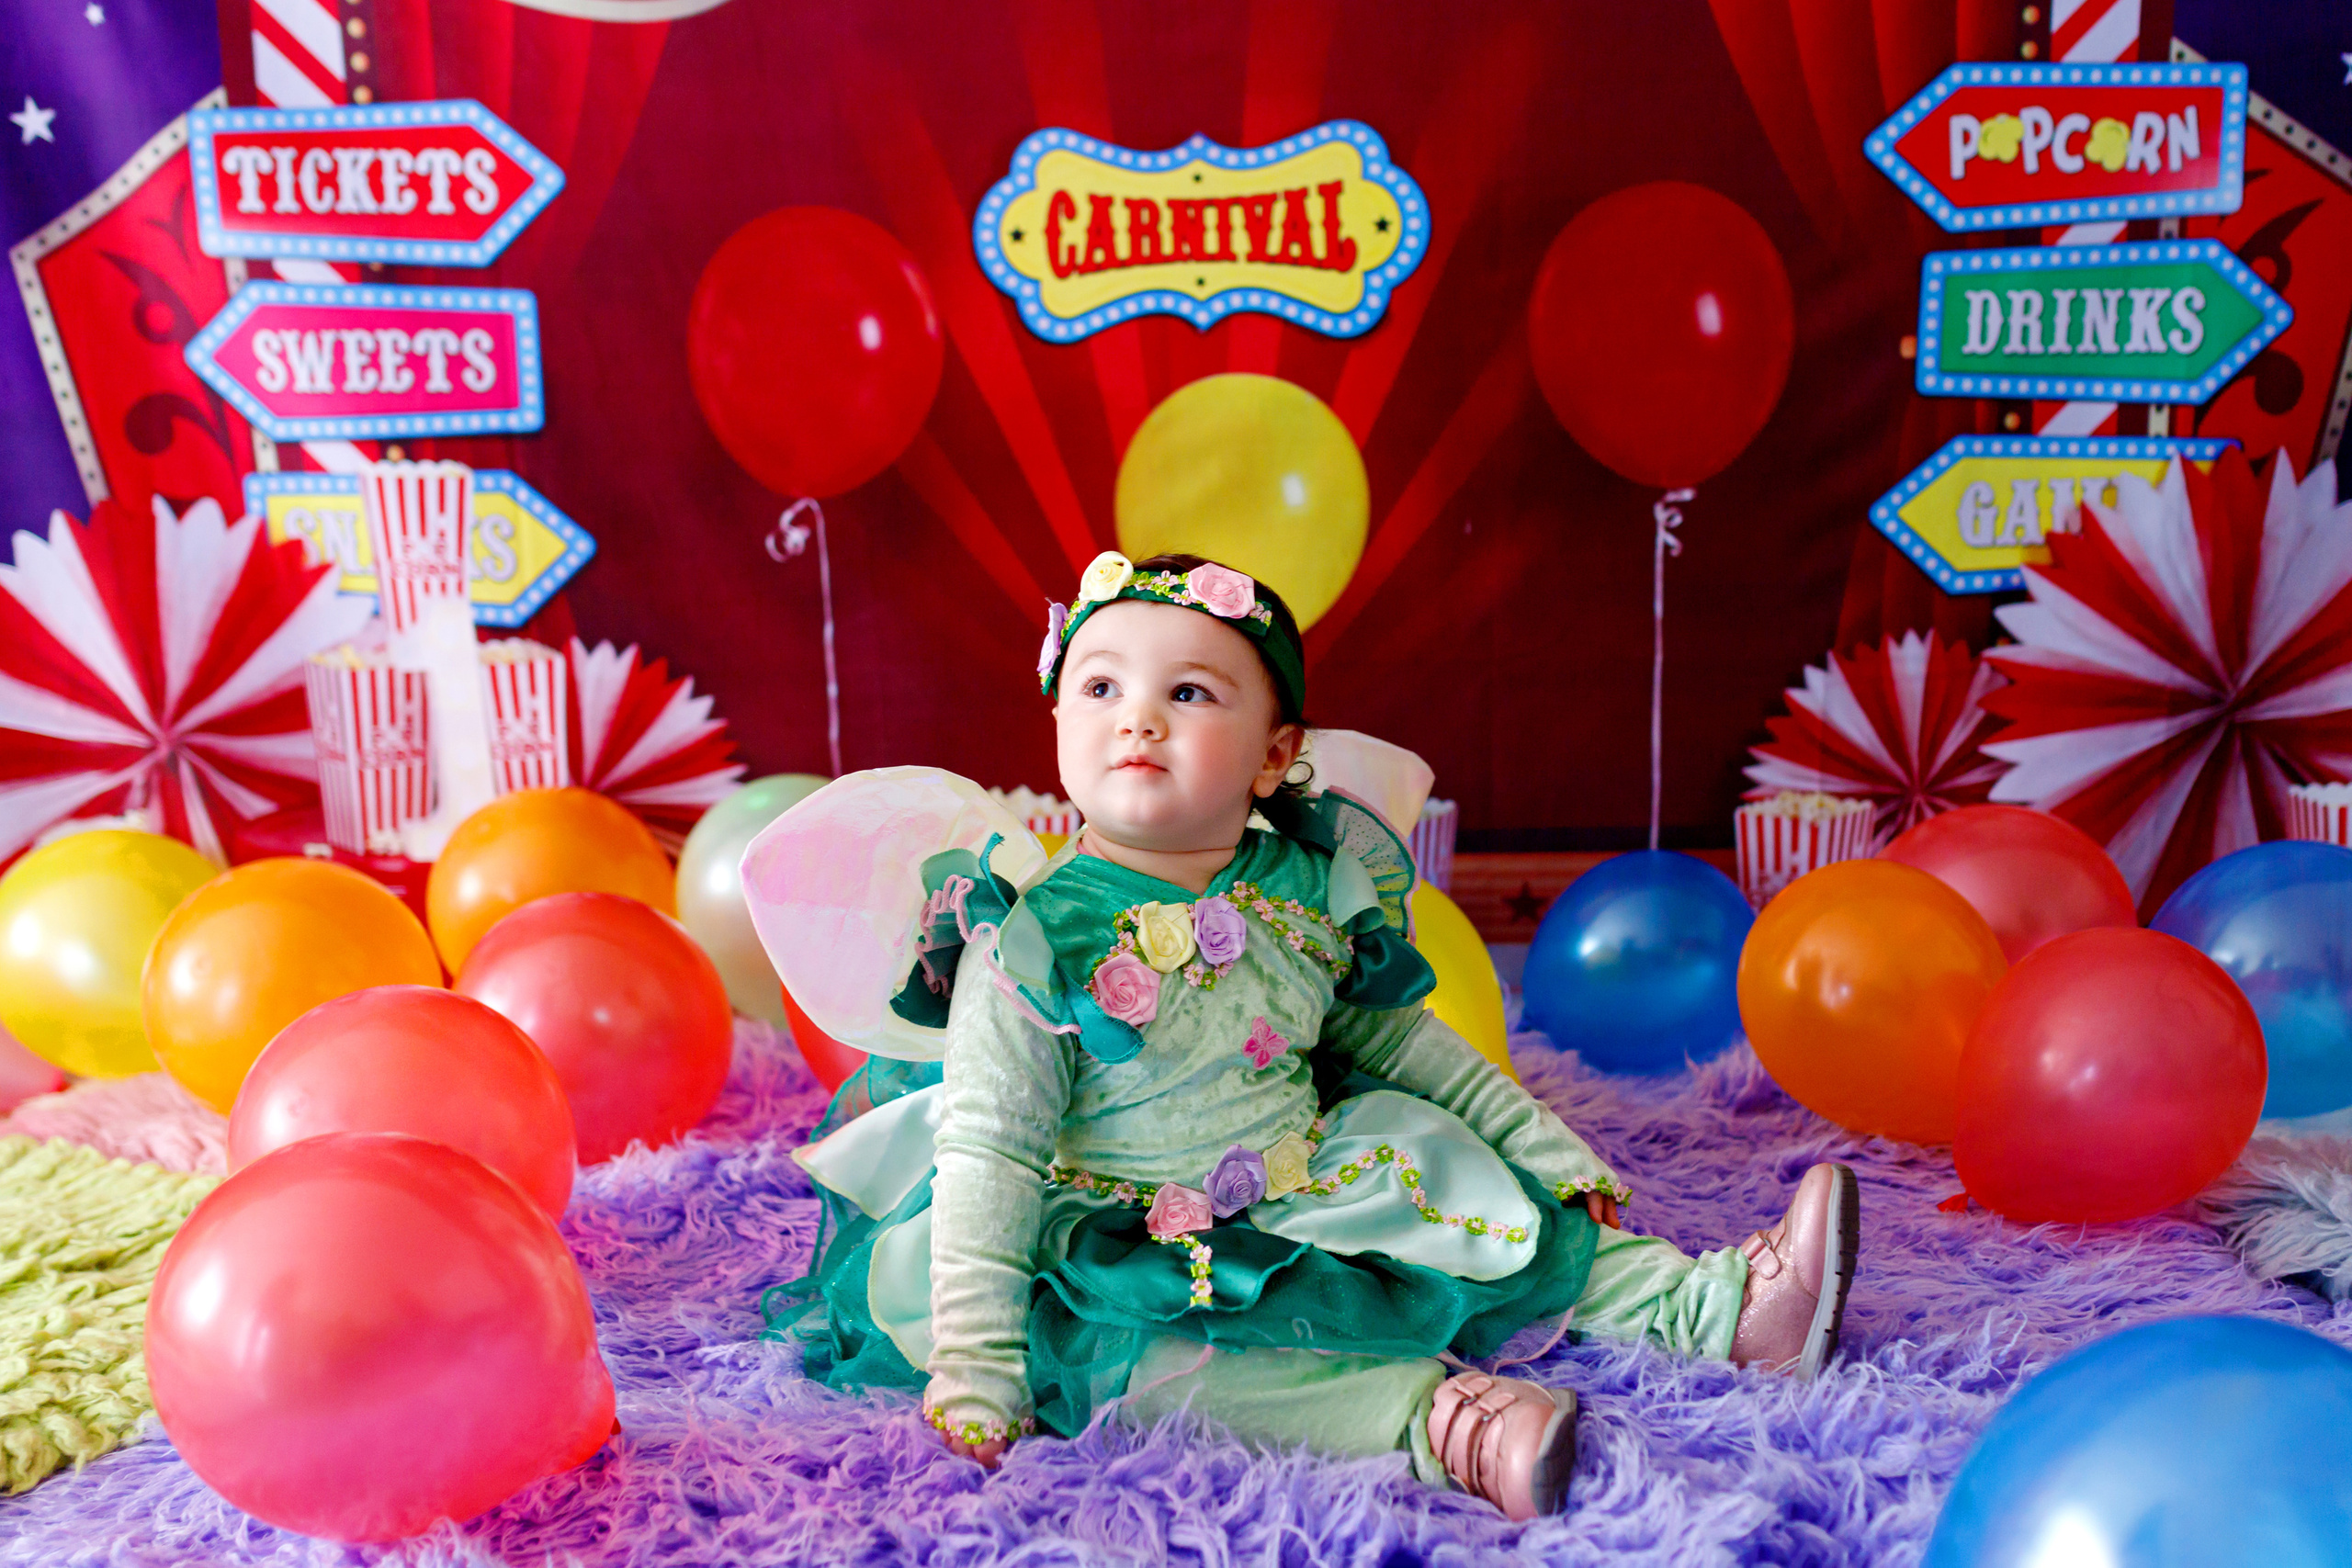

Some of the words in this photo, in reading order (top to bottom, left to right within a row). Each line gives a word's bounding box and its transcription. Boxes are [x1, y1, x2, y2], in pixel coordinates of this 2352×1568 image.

[221, 147, 499, 215] TICKETS
[1045, 180, 1360, 279] CARNIVAL
[1962, 287, 2208, 355] DRINKS
[252, 328, 497, 393] SWEETS
[284, 506, 517, 583] SNS
